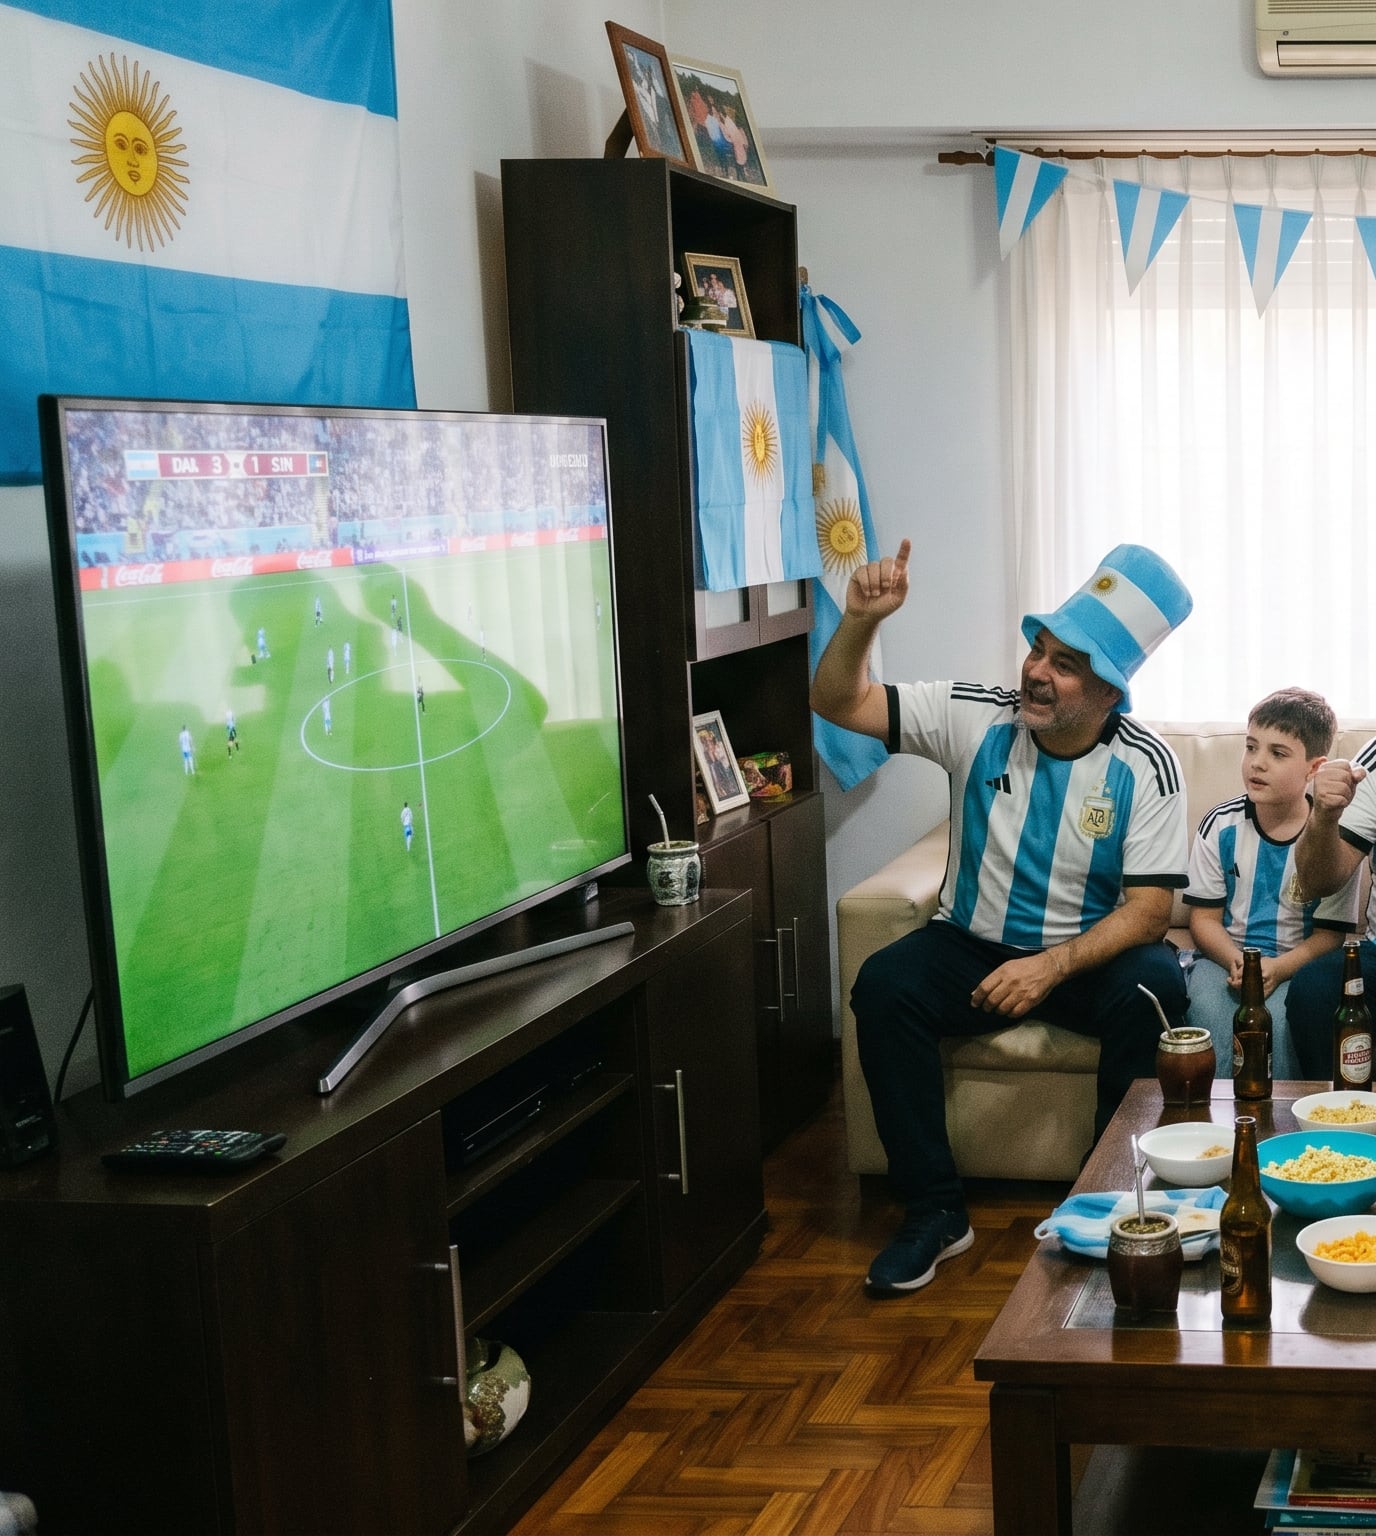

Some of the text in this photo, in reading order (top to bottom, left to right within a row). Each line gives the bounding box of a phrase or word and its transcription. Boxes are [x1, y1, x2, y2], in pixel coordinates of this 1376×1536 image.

[211, 455, 223, 474] 3
[251, 455, 259, 473] 1
[271, 456, 294, 473] SIN
